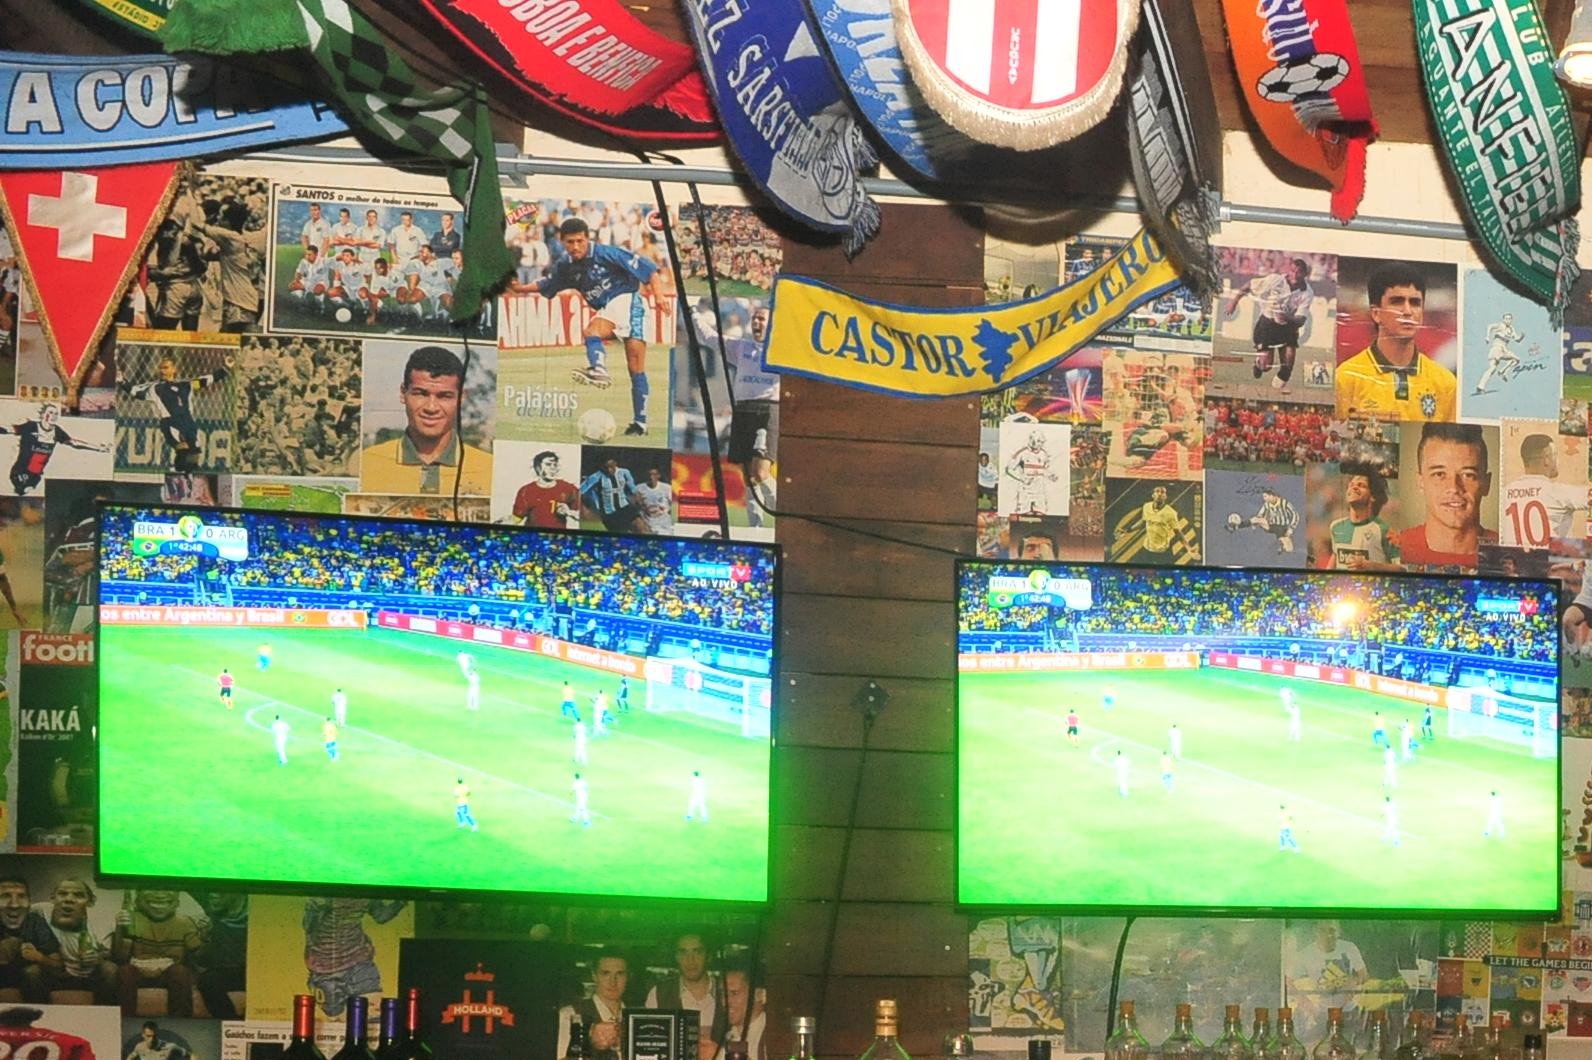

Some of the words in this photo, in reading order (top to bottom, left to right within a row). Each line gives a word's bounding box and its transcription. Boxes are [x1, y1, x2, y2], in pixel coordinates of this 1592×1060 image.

[5, 71, 64, 134] A
[295, 189, 336, 201] SANTOS
[810, 309, 975, 379] CASTOR
[1017, 230, 1167, 351] VIAJERO
[503, 384, 579, 410] Palácios
[1506, 486, 1542, 500] ROONEY
[1504, 501, 1551, 548] 10
[137, 524, 165, 537] BRA
[206, 528, 214, 538] 0
[219, 529, 246, 541] ARG
[691, 578, 707, 588] AO
[711, 579, 739, 590] VIVO
[19, 705, 81, 732] KAKÁ
[1489, 956, 1509, 967] LET
[1510, 957, 1530, 968] THE
[1531, 958, 1567, 970] GAMES
[453, 1004, 504, 1016] HOLLAND
[224, 1030, 256, 1041] Gaúchos
[257, 1030, 279, 1040] fazem
